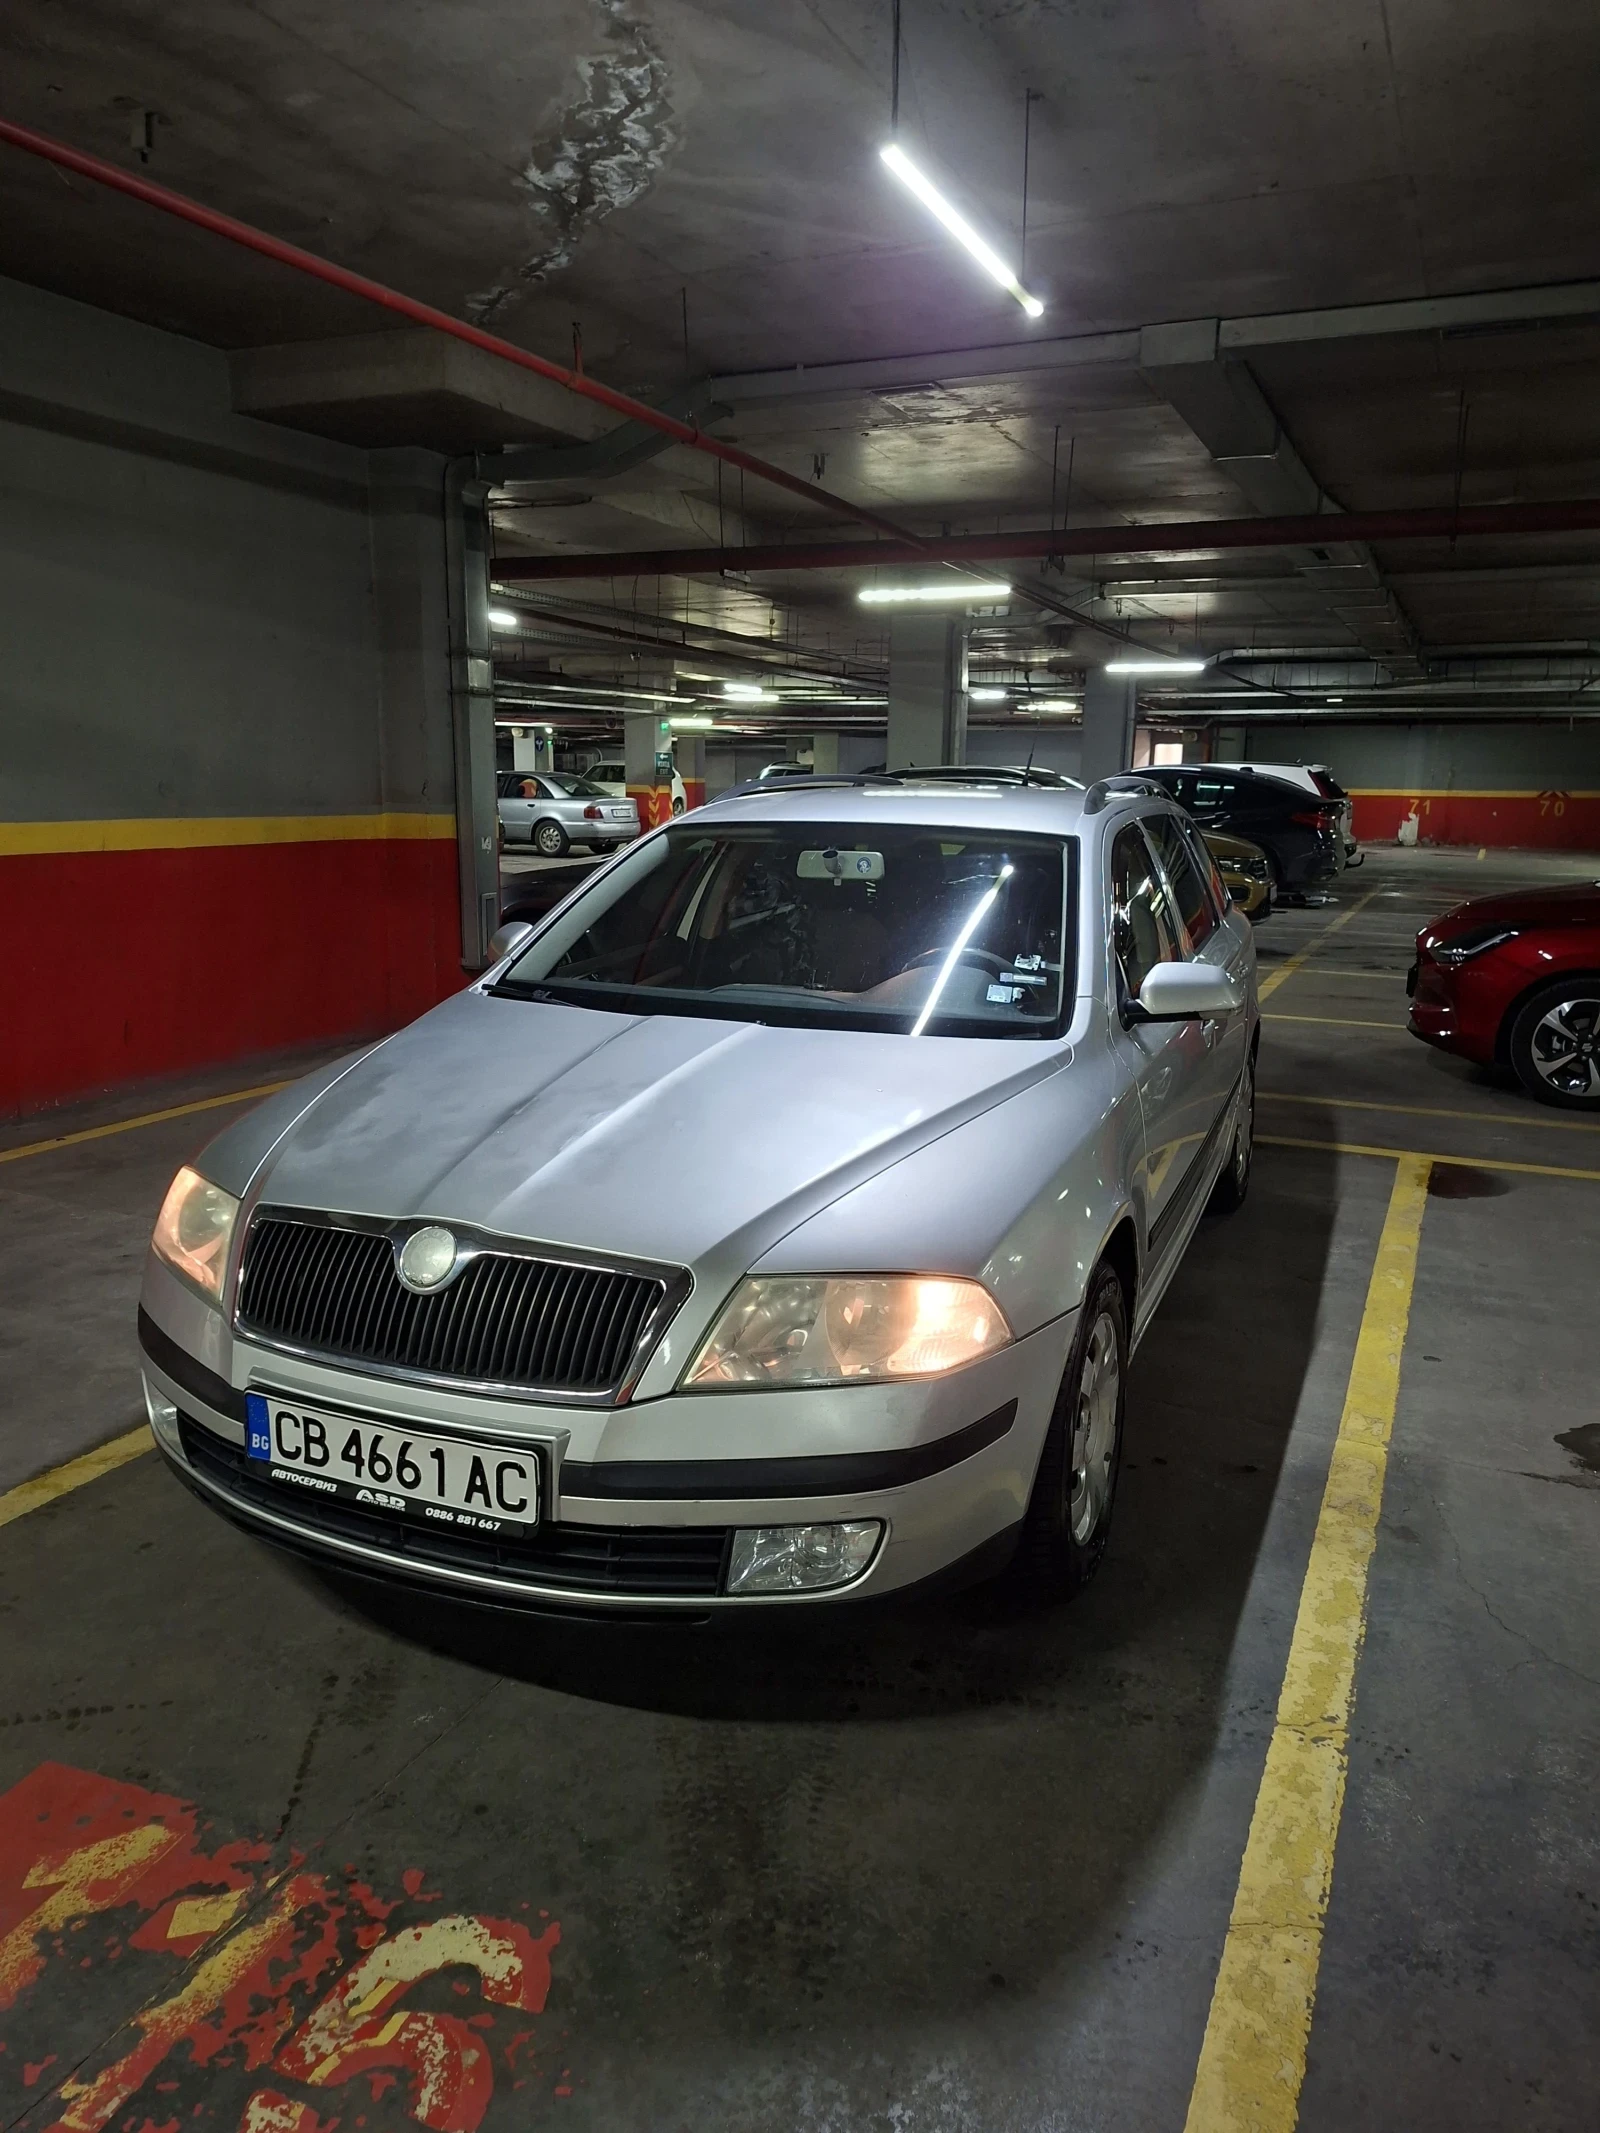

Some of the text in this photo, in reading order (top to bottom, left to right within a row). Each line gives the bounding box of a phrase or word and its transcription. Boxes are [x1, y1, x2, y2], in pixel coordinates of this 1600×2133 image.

[1409, 799, 1431, 815] 71
[1540, 800, 1565, 817] 70
[251, 1432, 269, 1451] BG
[275, 1411, 528, 1513] CB 4661 AC
[271, 1468, 338, 1492] АВТОСЕРВИЗ
[425, 1507, 502, 1531] 0886 881 667
